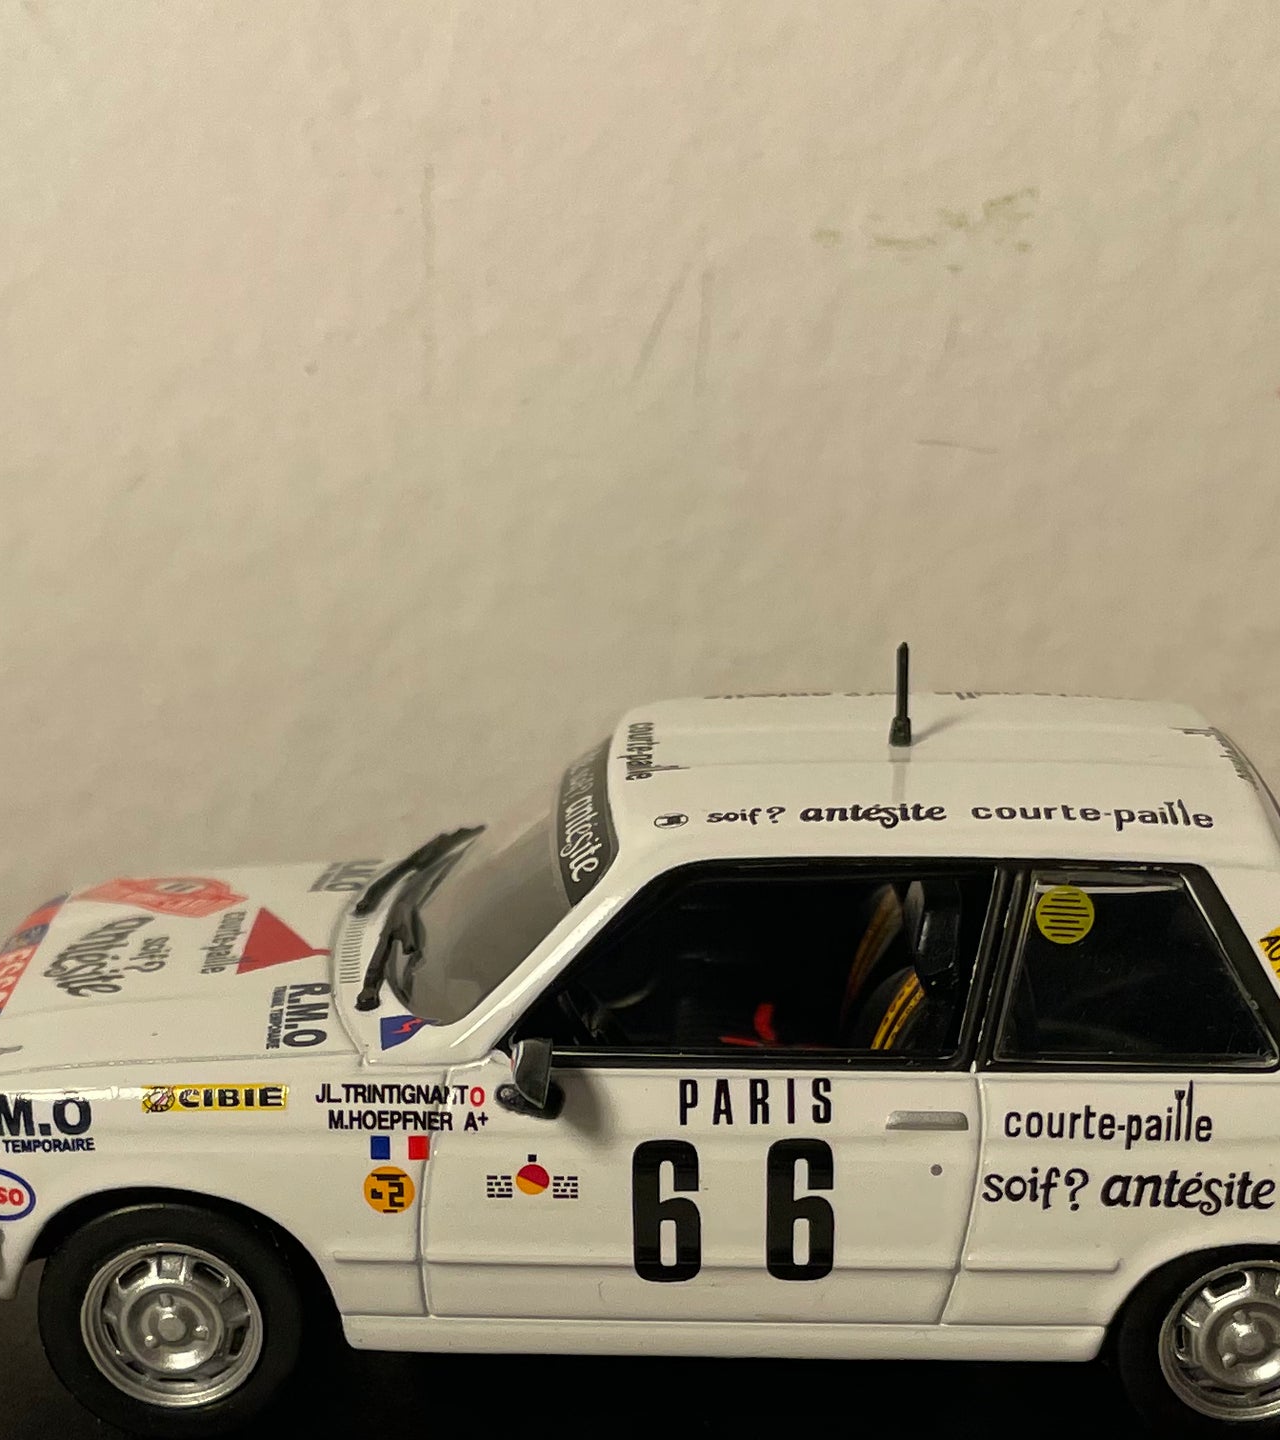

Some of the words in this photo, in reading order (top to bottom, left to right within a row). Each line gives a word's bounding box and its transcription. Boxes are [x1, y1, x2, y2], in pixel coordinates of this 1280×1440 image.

[706, 806, 786, 826] soif?
[799, 803, 947, 830] antésite
[971, 798, 1214, 832] courte-paille
[282, 982, 332, 1047] R.M.O
[179, 1087, 283, 1108] CIBIE
[679, 1077, 832, 1126] PARIS
[1004, 1079, 1213, 1151] courte-paille
[326, 1108, 453, 1132] M.HOEPFNER
[463, 1111, 489, 1132] A+
[1, 1137, 96, 1154] TEMPORAIRE
[982, 1166, 1090, 1212] soif?
[1100, 1169, 1276, 1217] antésite
